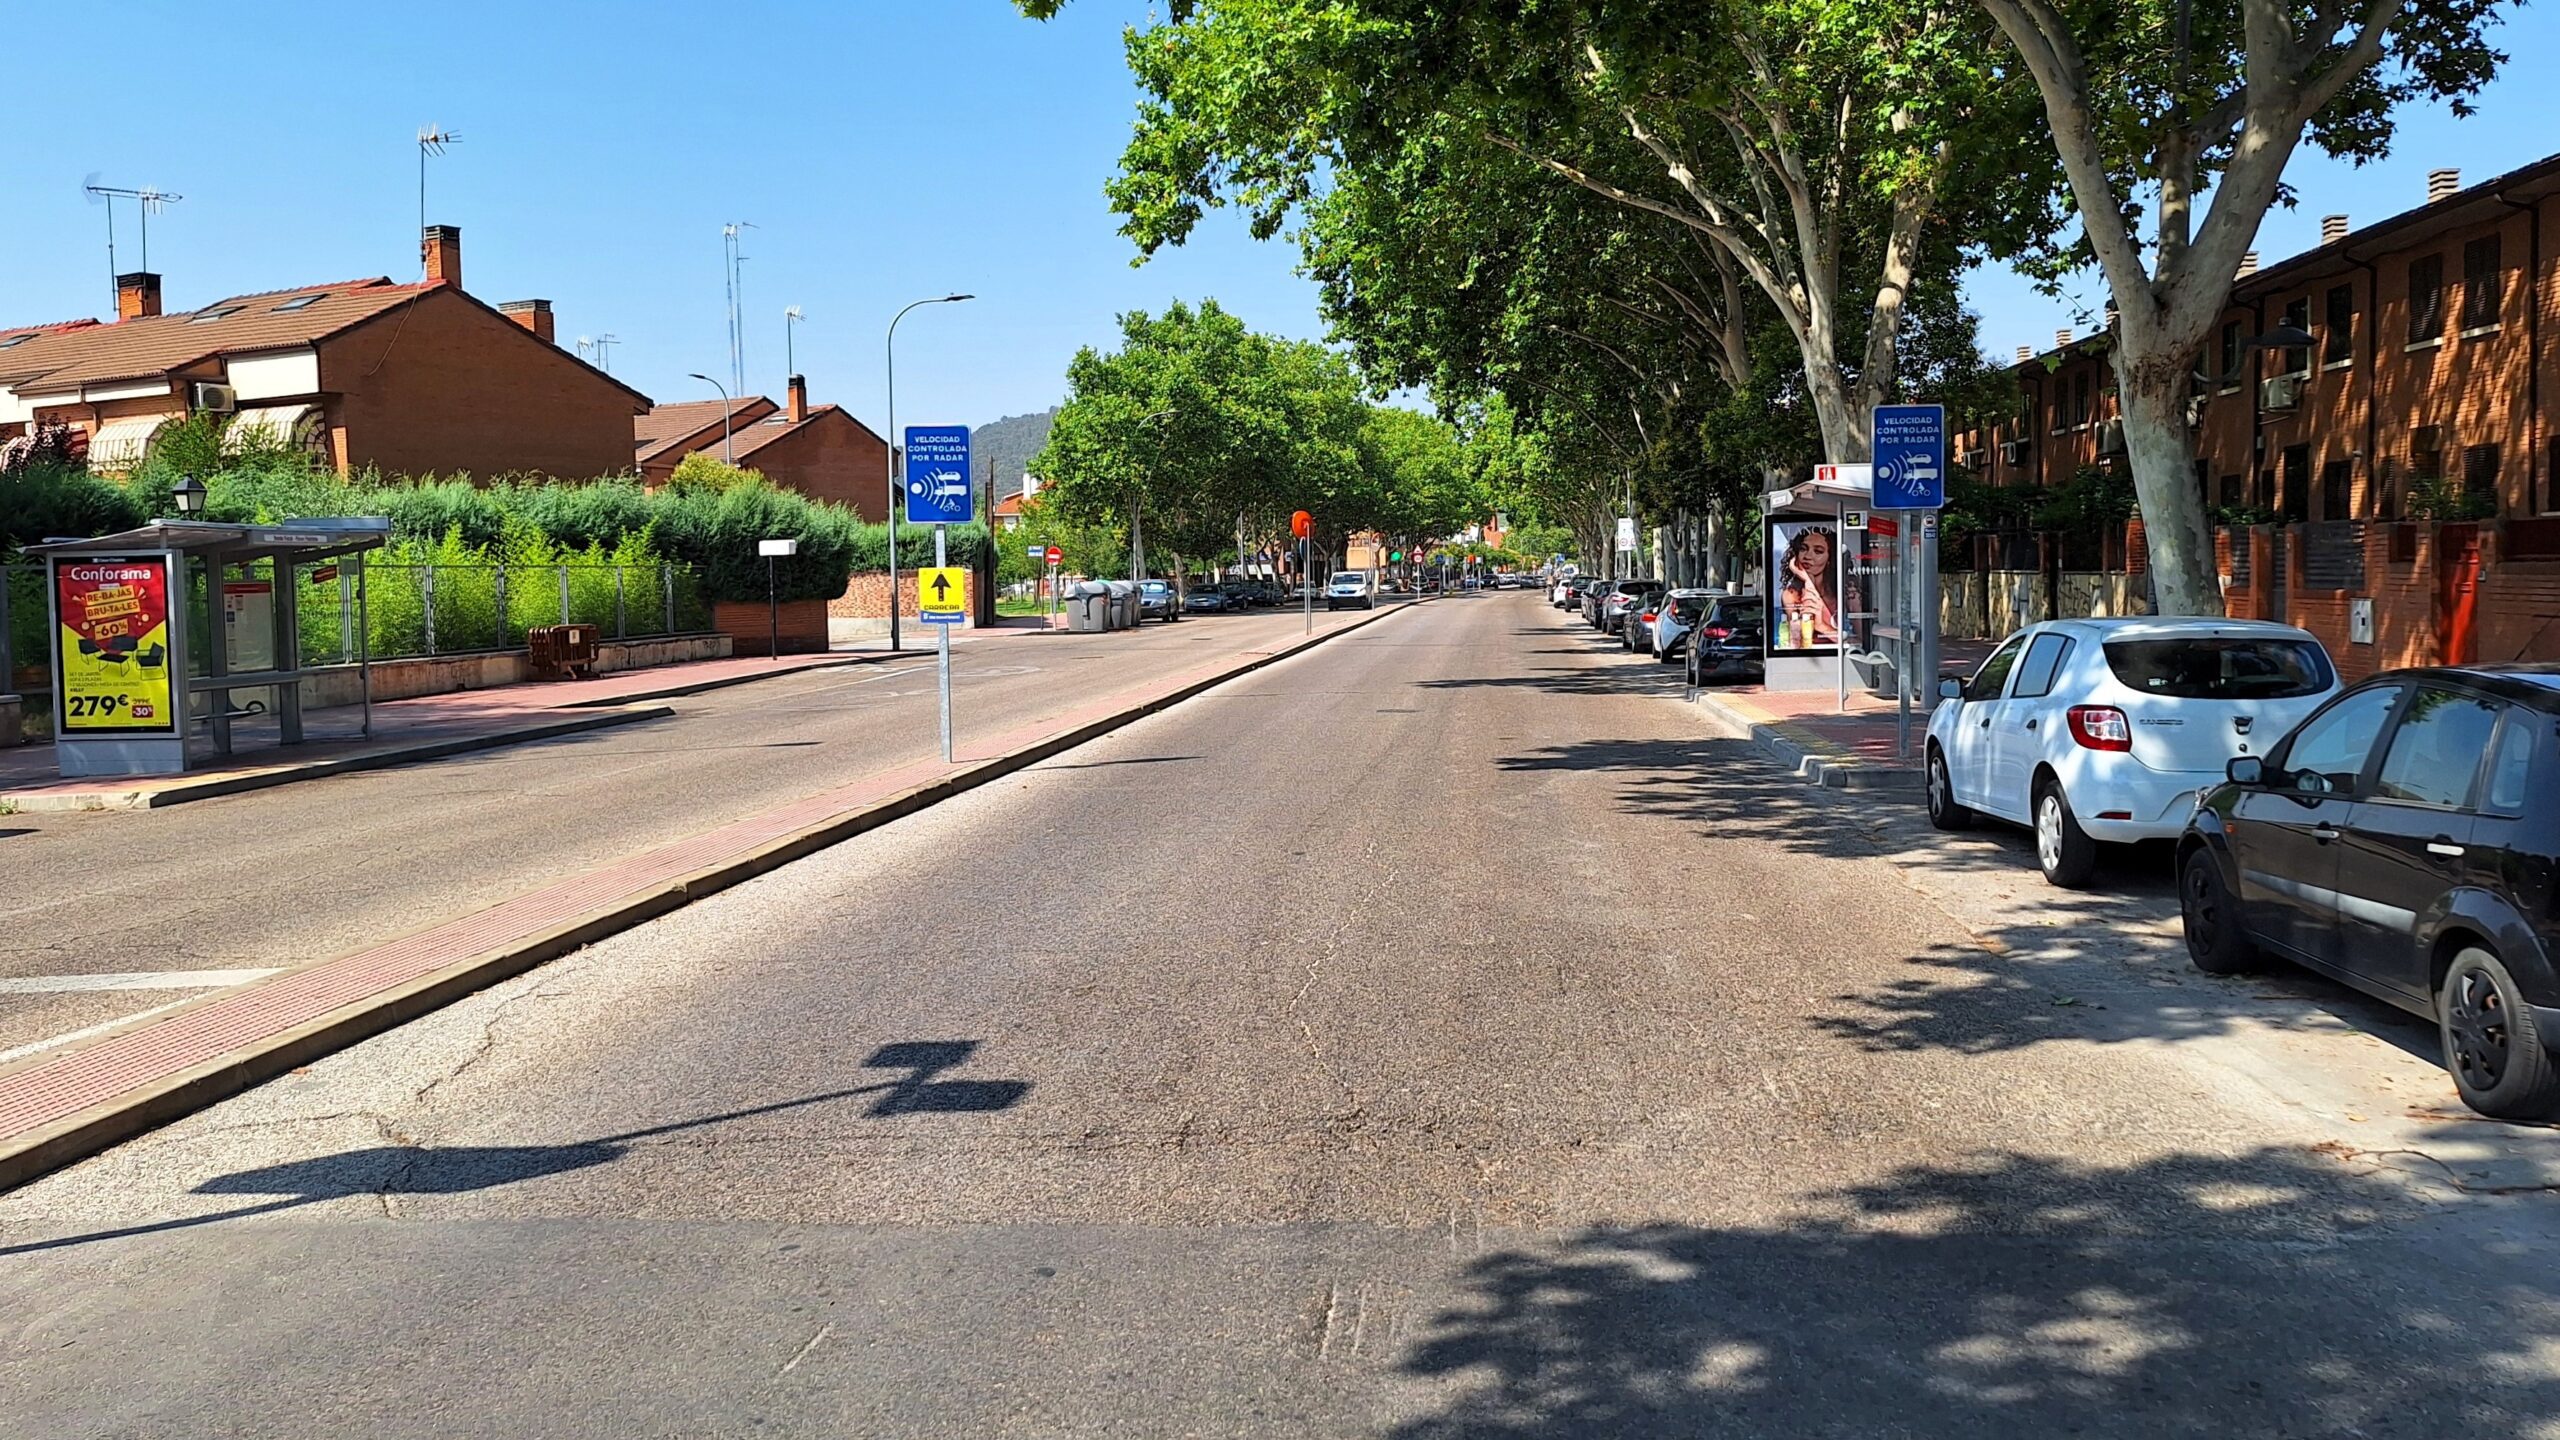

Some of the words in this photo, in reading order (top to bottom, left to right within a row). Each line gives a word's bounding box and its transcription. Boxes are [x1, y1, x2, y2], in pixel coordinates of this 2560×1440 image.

[1884, 417, 1933, 425] VELOCIDAD
[1876, 426, 1940, 435] CONTROLADA
[71, 567, 151, 582] Conforama
[69, 694, 129, 717] 279€
